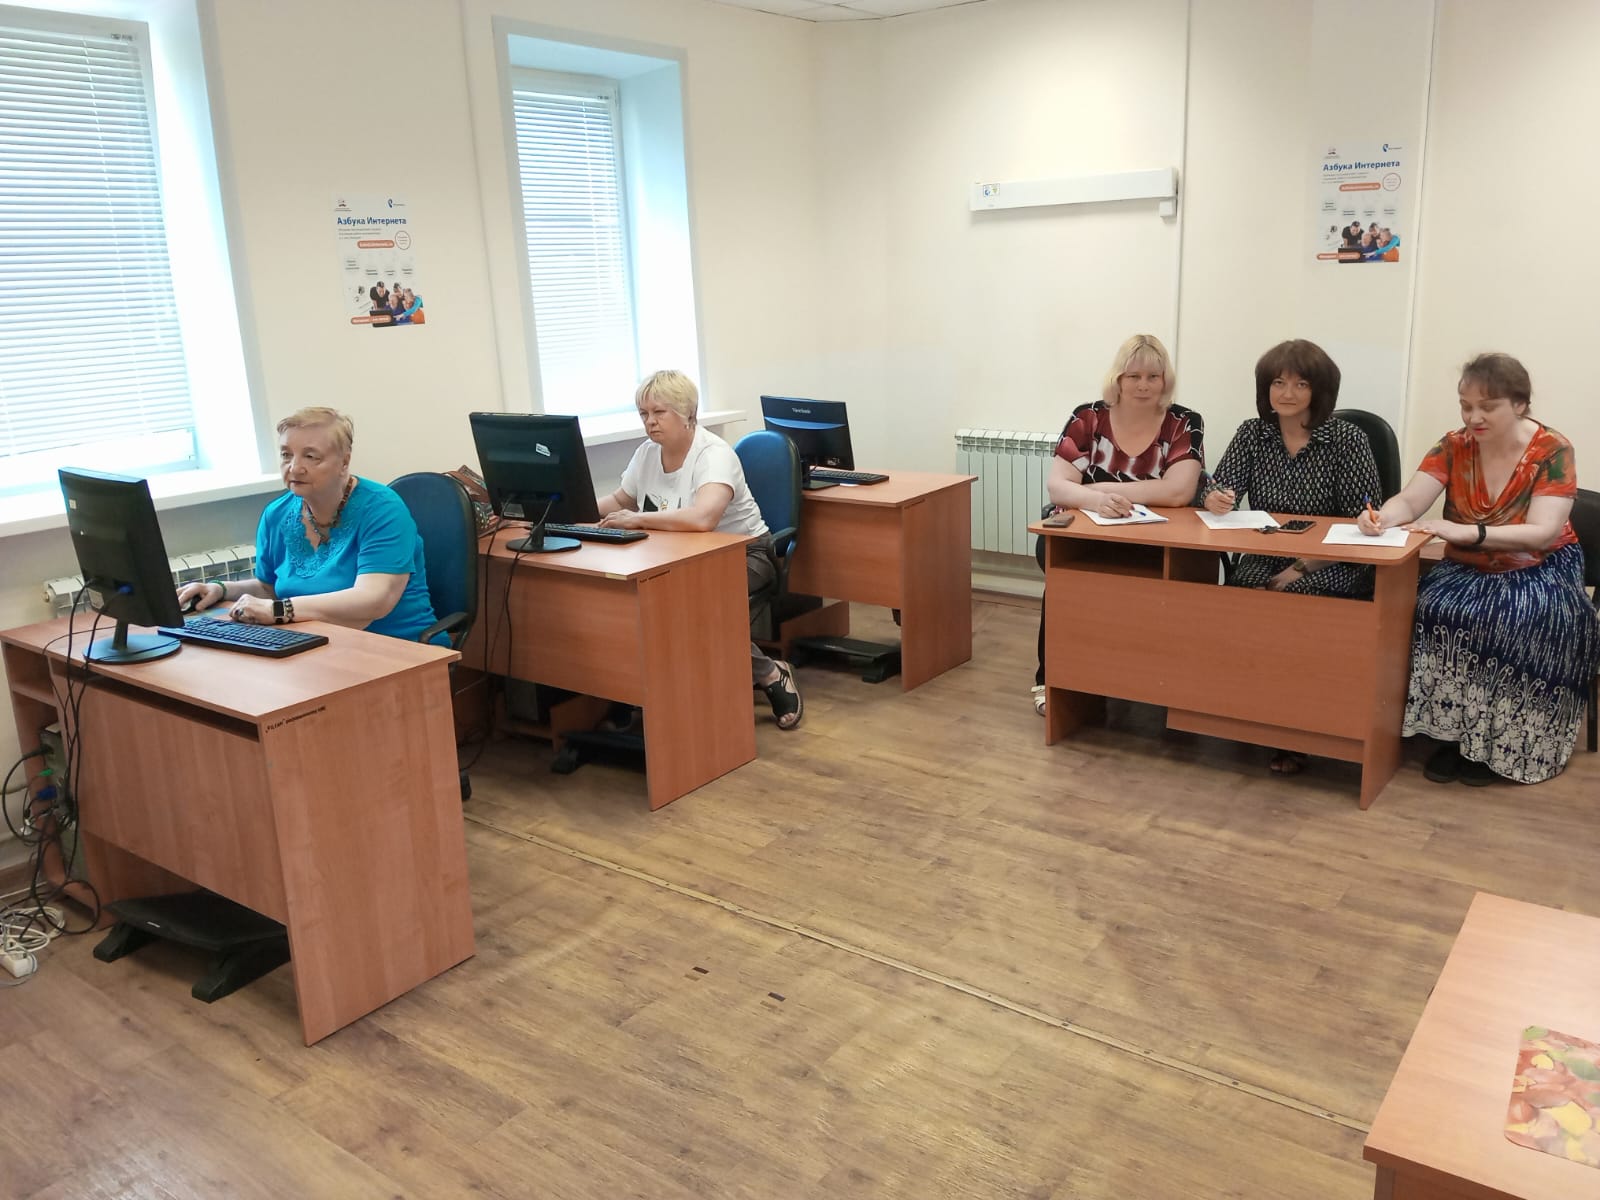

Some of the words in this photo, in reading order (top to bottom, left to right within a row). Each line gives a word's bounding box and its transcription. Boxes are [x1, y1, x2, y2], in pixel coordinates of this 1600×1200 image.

[1323, 163, 1353, 172] Азбука
[1354, 160, 1401, 170] Интернета
[337, 217, 365, 226] Азбука
[367, 217, 407, 226] Интернета
